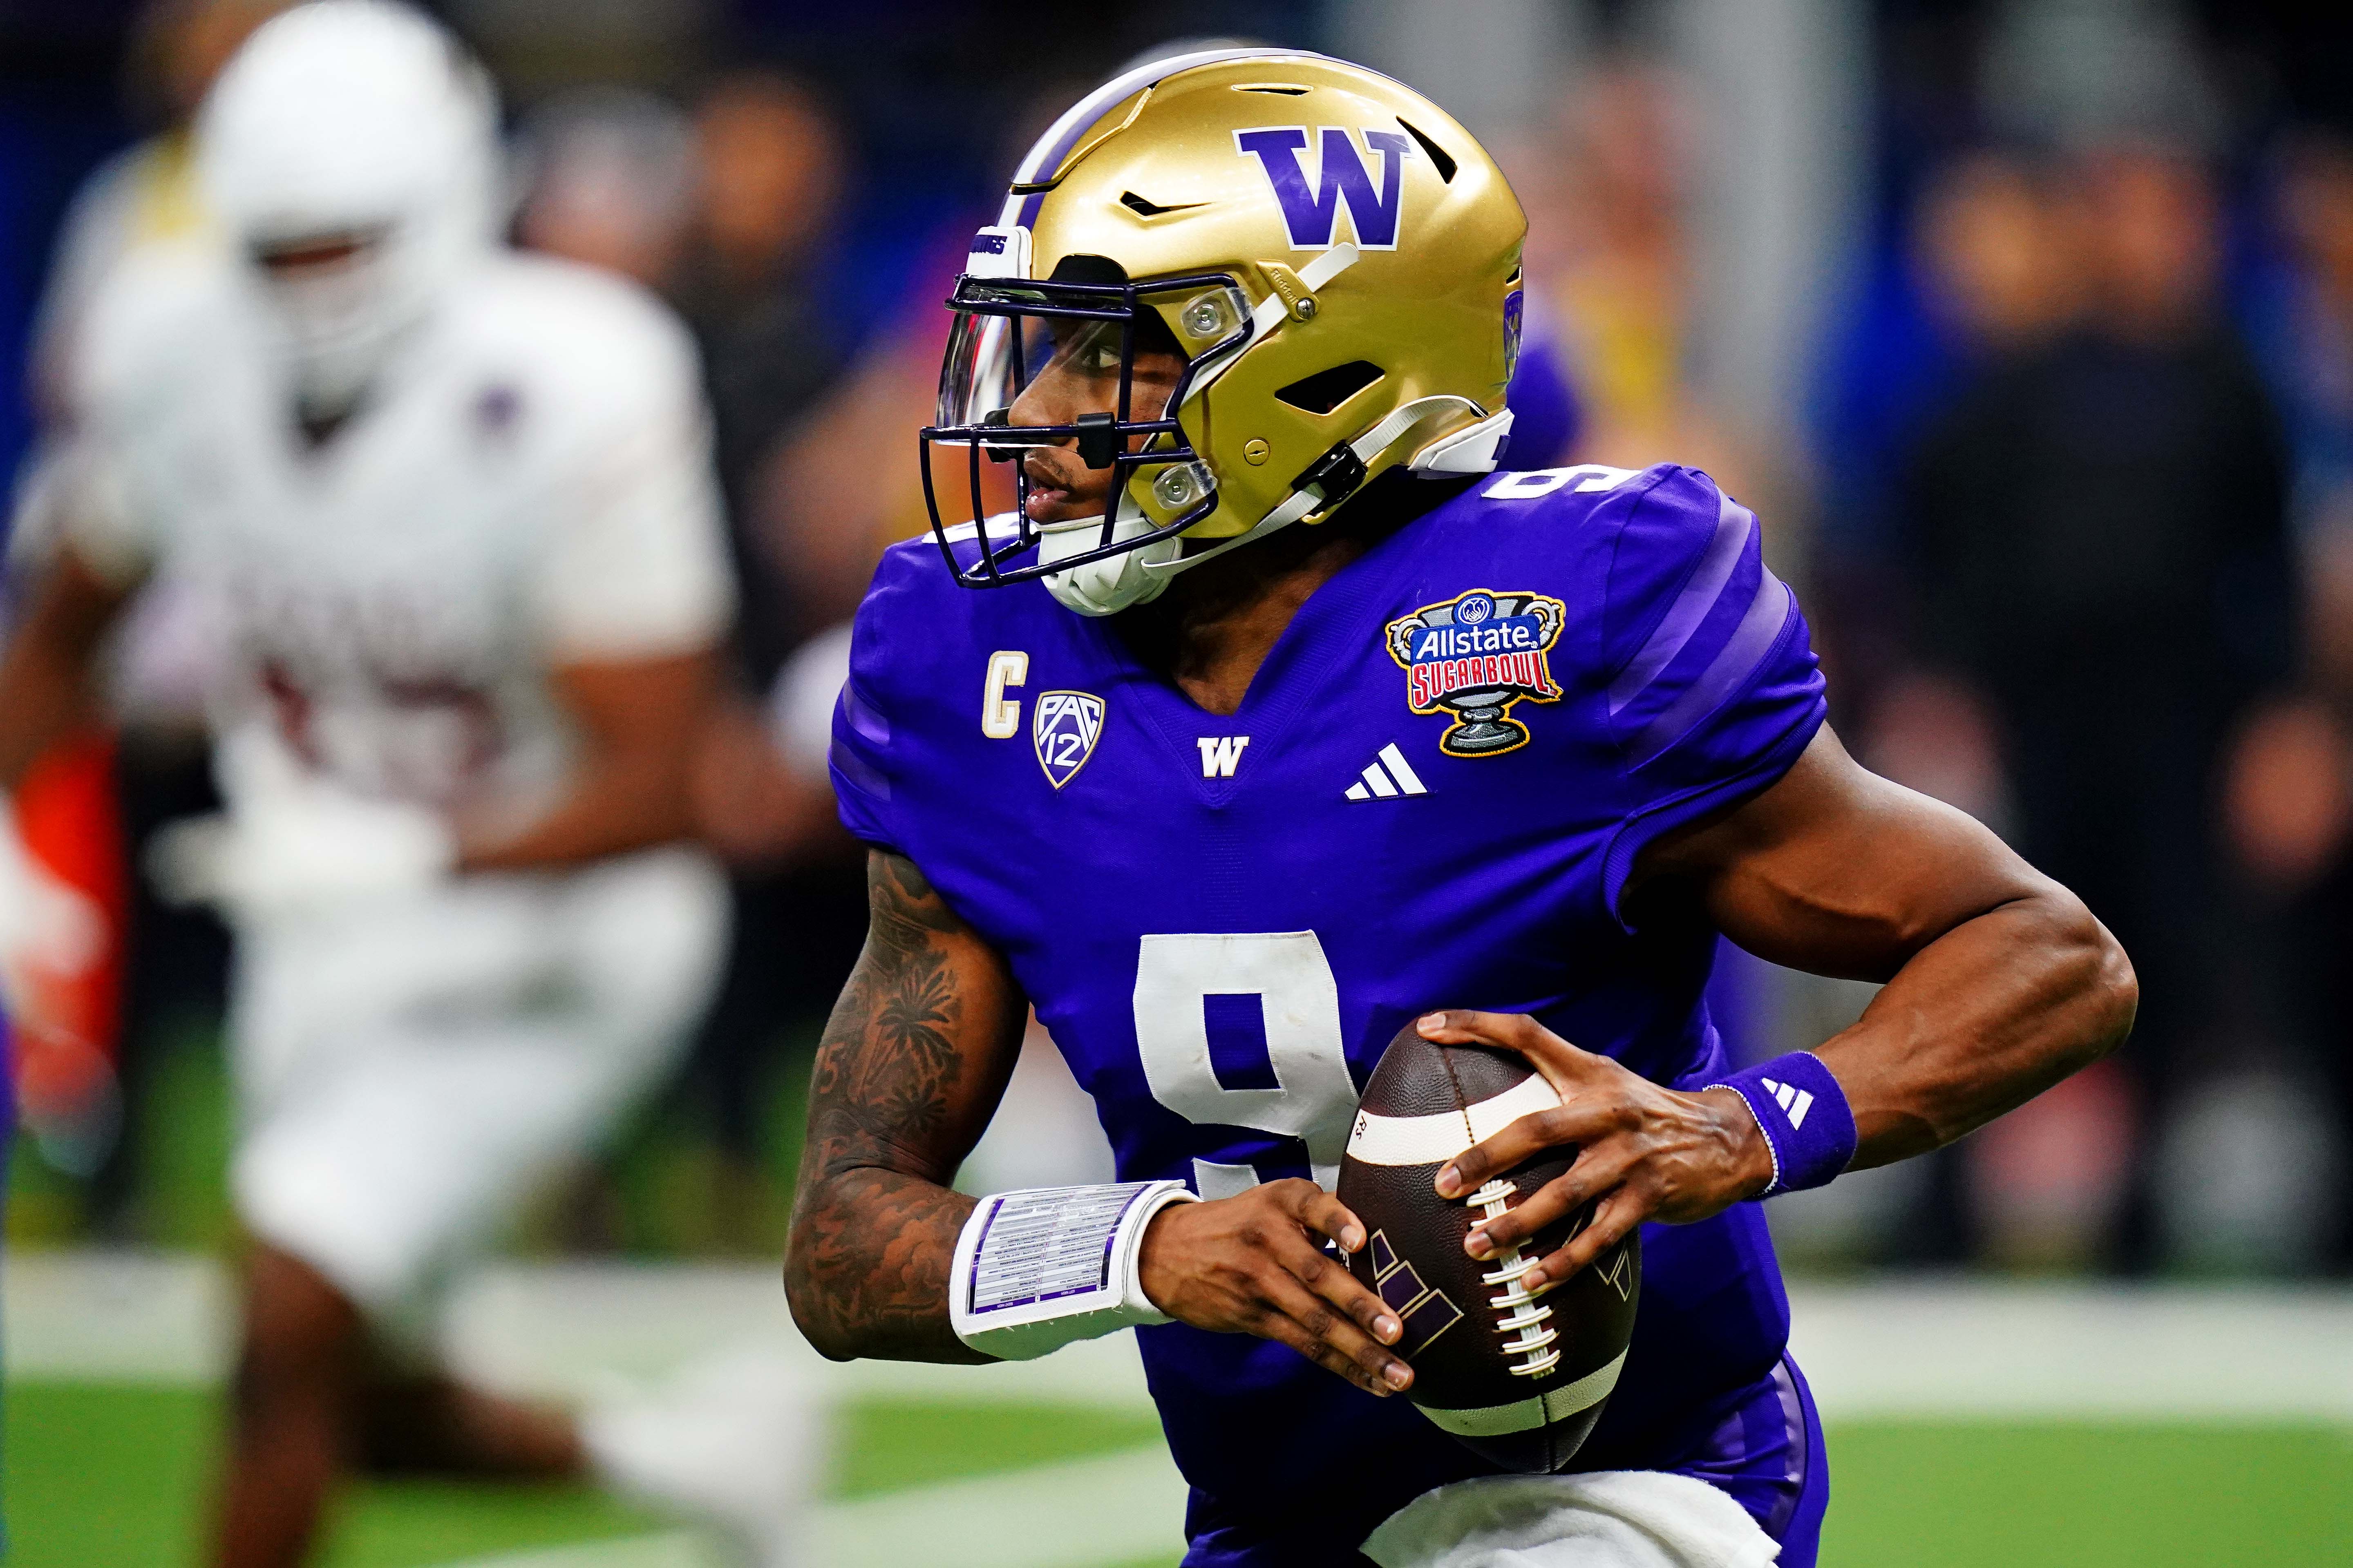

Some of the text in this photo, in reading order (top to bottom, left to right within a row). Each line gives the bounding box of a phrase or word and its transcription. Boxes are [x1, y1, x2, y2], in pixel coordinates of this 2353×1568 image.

[1231, 125, 1416, 252] W
[982, 650, 1029, 739] C
[1037, 696, 1100, 752] PAC
[1045, 733, 1082, 767] 12
[1197, 736, 1250, 777] W
[1133, 929, 1362, 1202] 9
